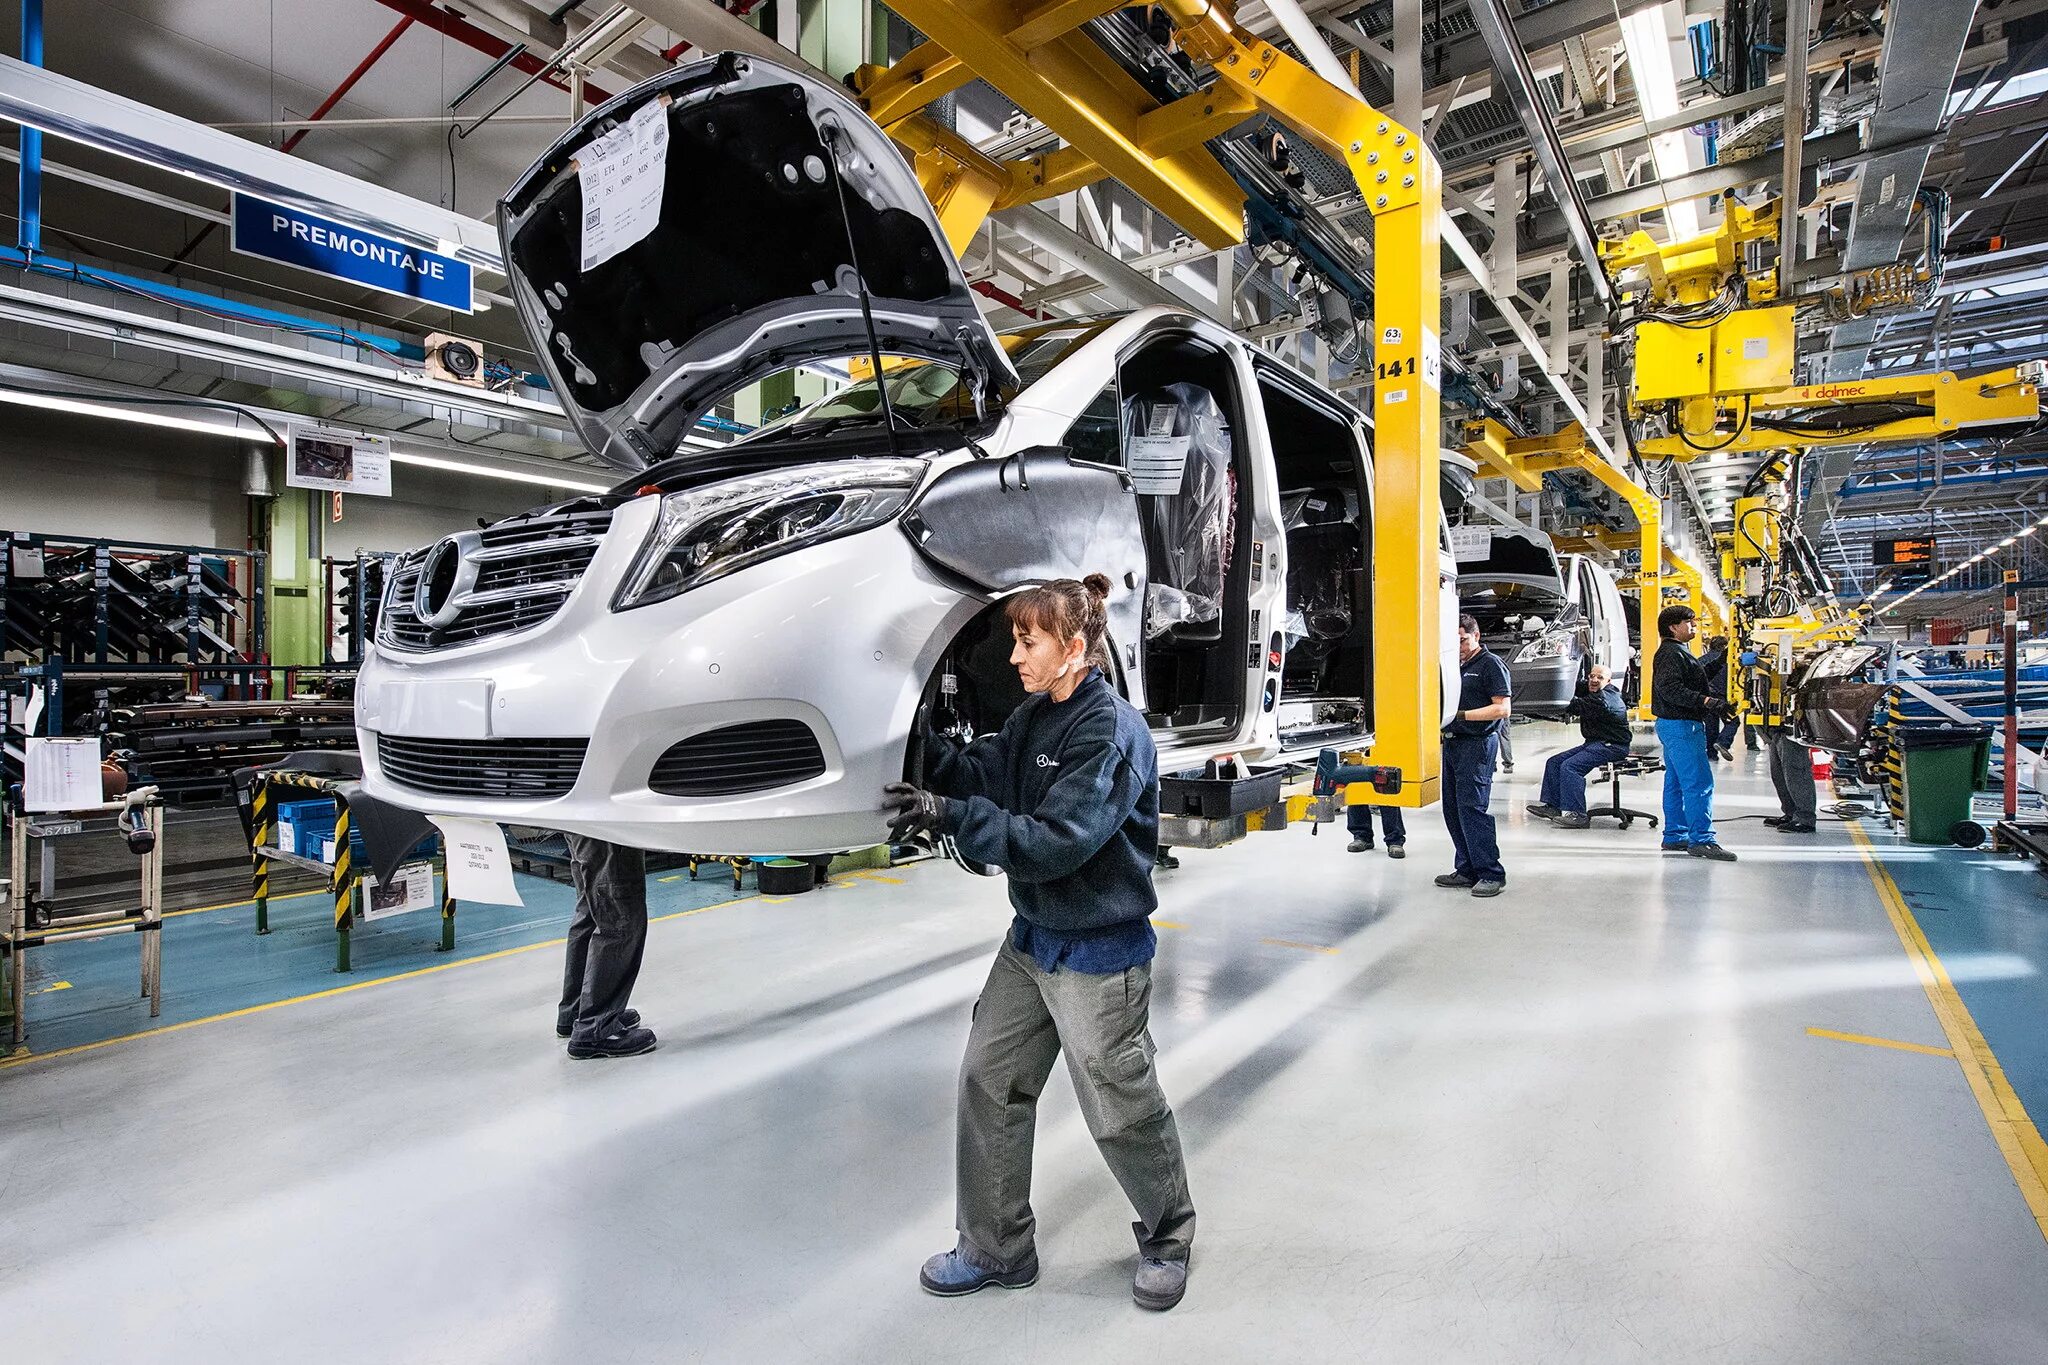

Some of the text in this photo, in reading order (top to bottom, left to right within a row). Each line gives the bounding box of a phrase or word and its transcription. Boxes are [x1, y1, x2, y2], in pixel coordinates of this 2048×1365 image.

[272, 214, 445, 281] PREMONTAJE
[1385, 328, 1399, 338] 63
[1377, 356, 1415, 380] 141
[1816, 385, 1866, 399] dalmec
